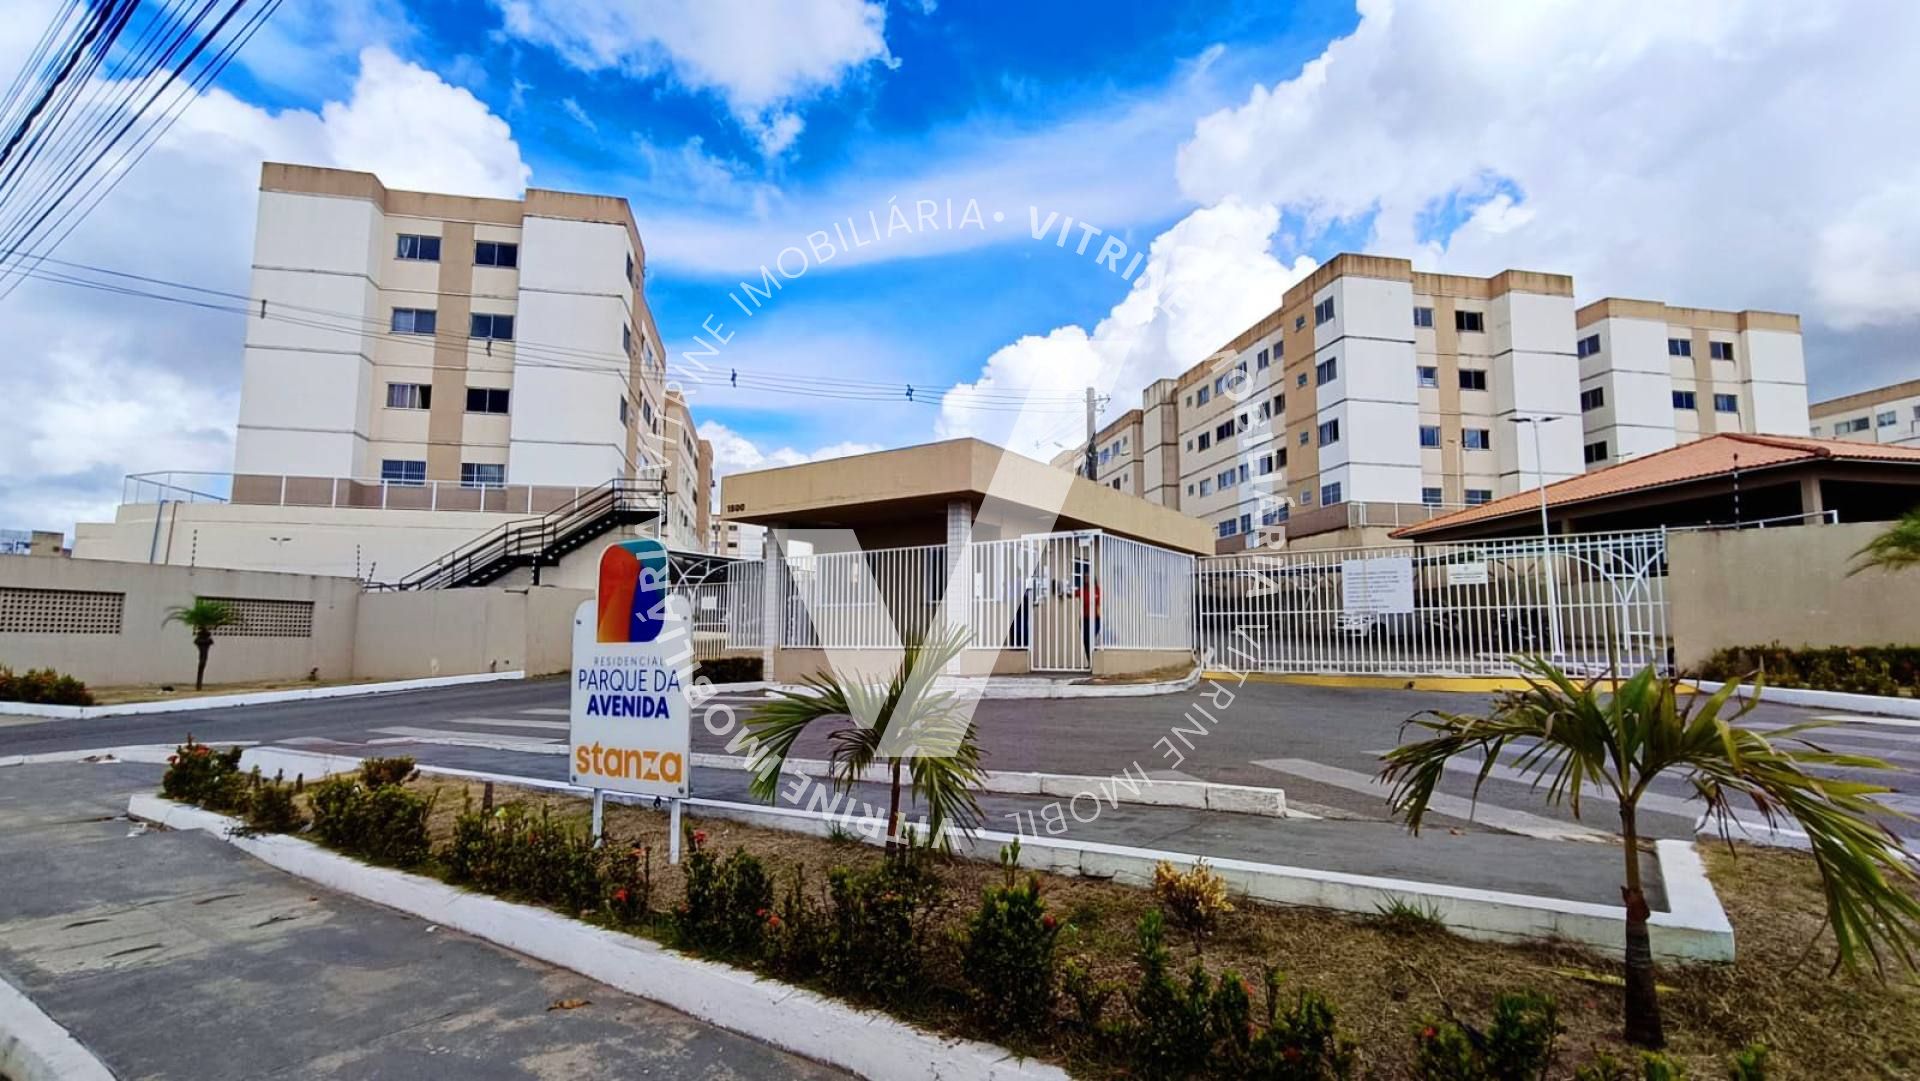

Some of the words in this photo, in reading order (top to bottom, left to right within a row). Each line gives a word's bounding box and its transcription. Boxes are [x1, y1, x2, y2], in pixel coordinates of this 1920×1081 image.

[594, 655, 665, 667] RESIDENCIAL
[578, 668, 648, 693] PARQUE
[653, 669, 681, 693] DA
[586, 694, 670, 720] AVENIDA
[575, 741, 683, 783] stanza
